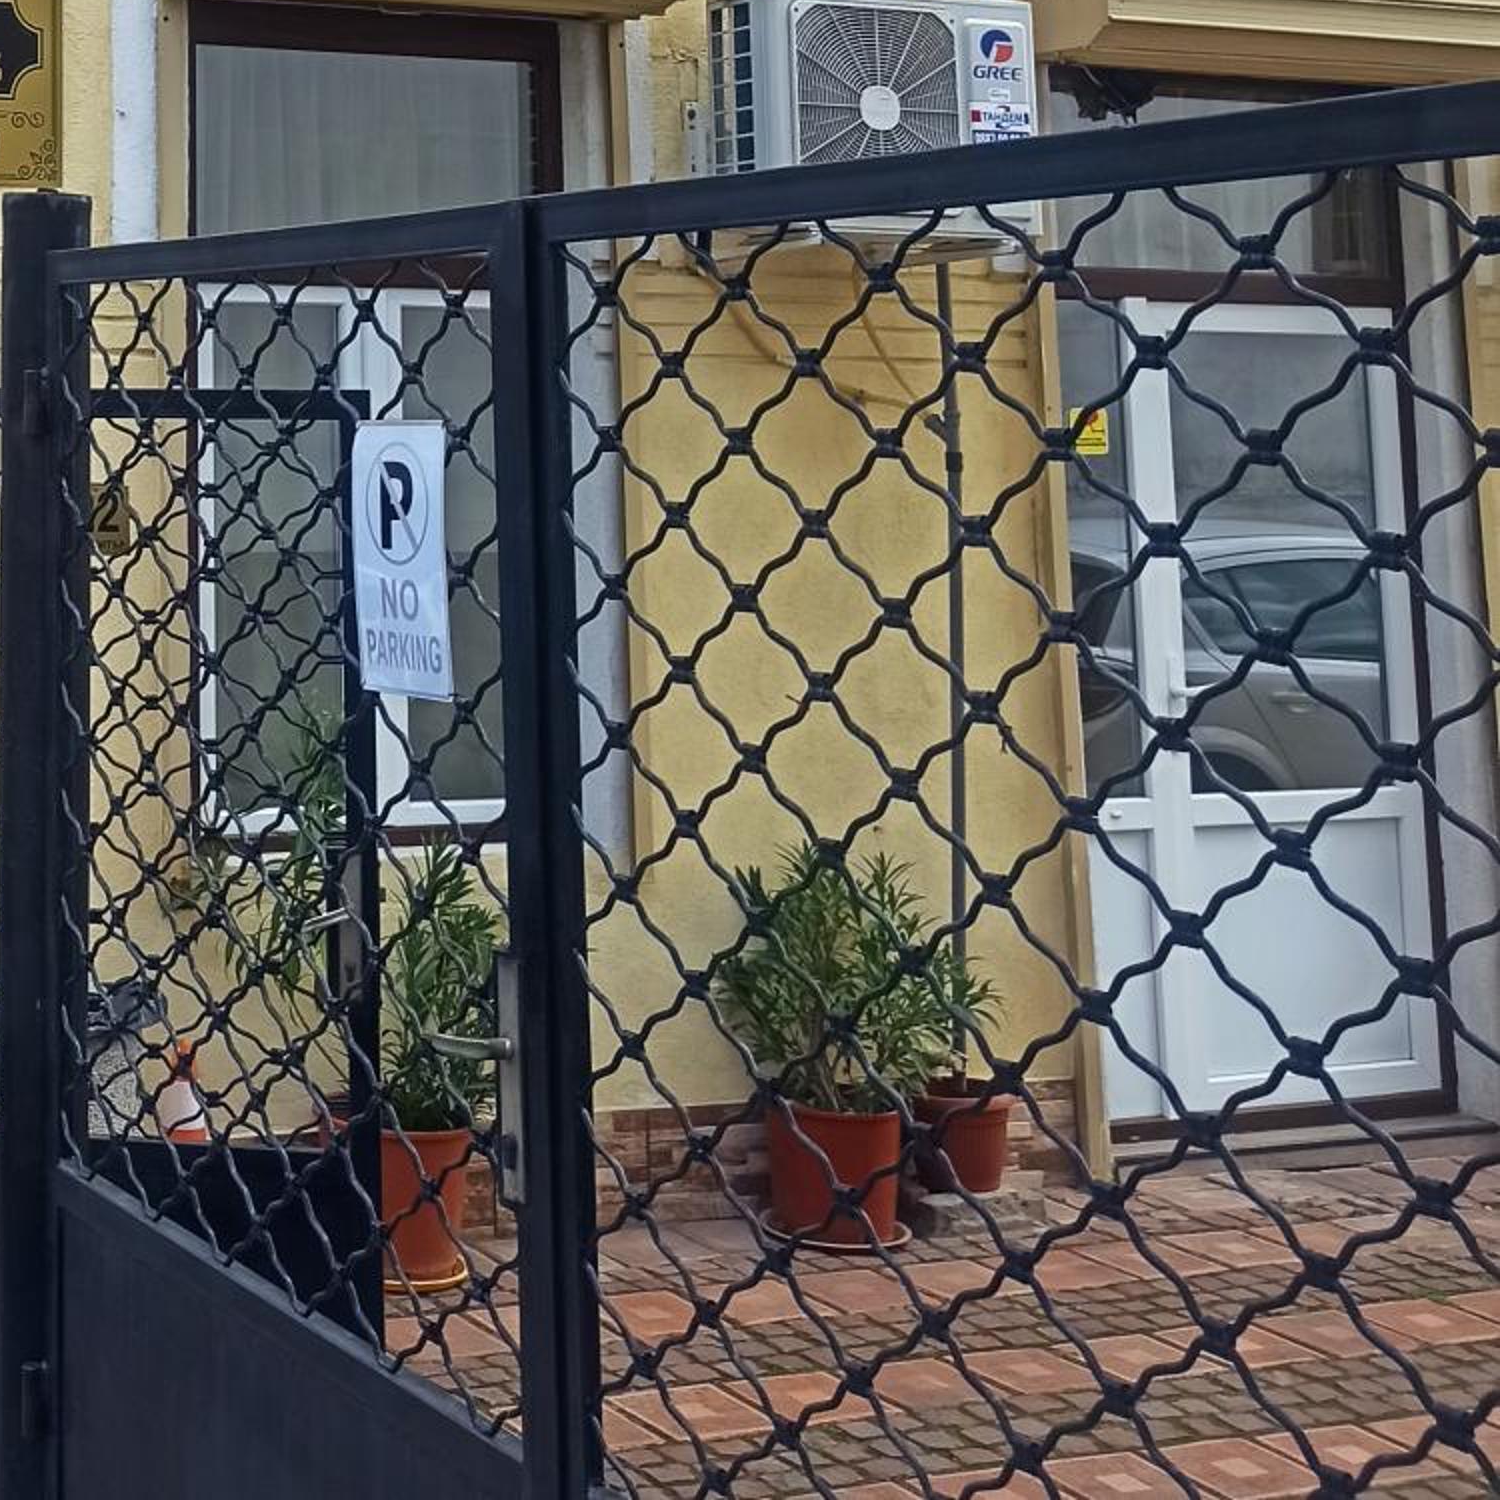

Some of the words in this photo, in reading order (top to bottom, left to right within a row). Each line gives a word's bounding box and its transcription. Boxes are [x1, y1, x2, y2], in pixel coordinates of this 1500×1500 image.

[973, 64, 1023, 81] GREE
[380, 578, 419, 621] NO
[366, 628, 443, 675] PARKING
